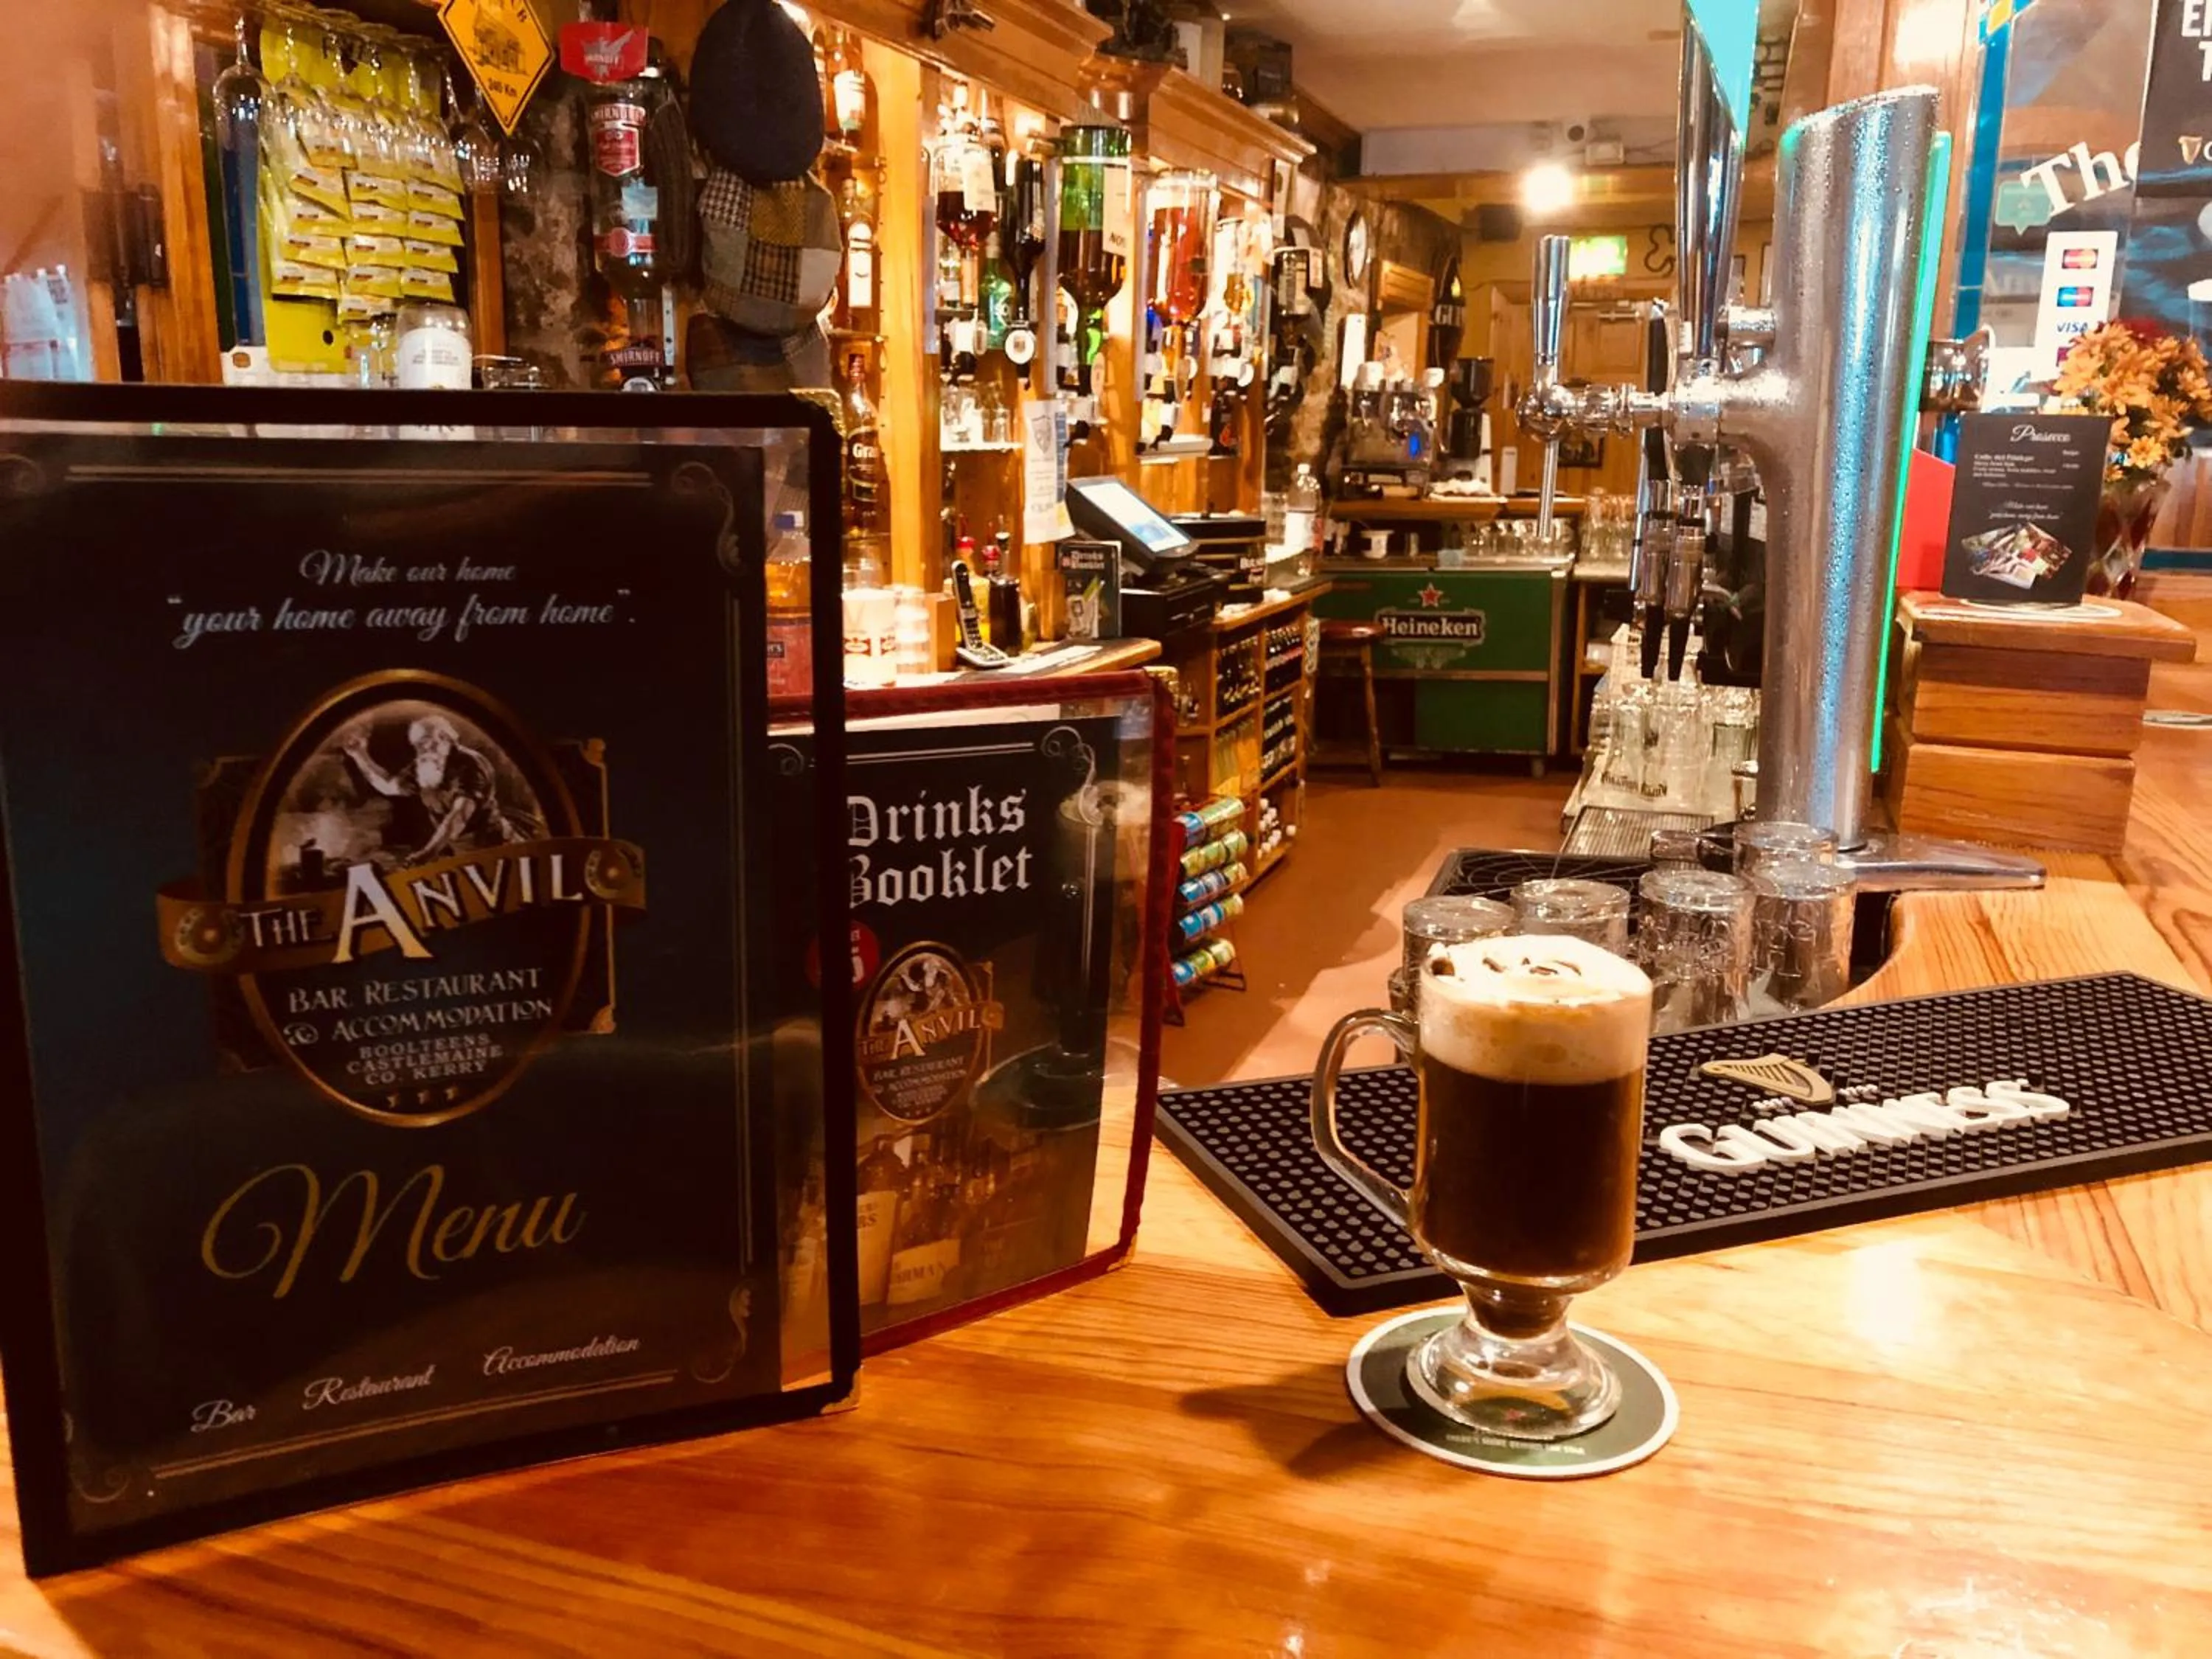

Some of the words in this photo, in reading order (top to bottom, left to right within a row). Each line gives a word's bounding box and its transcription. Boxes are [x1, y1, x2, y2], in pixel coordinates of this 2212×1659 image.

[2056, 321, 2089, 333] VISA
[610, 349, 661, 365] SMIRNOFF
[299, 549, 396, 585] Make
[406, 563, 447, 582] our
[456, 557, 516, 582] home
[272, 598, 355, 631] home
[366, 605, 447, 641] away
[454, 593, 529, 642] from
[1382, 616, 1479, 636] Heineken
[847, 785, 1027, 847] Drinks
[849, 844, 1033, 909] Booklet
[239, 907, 333, 947] THE
[331, 854, 584, 964] ANVIL
[288, 987, 349, 1014] BAR
[364, 967, 543, 1005] RESTAURANT
[332, 998, 553, 1043] ACCOMMODATION
[891, 1009, 981, 1060] ANVIL
[346, 1044, 504, 1074] CASTLEMAINE
[358, 1032, 491, 1060] BOOLTEENS
[413, 1060, 487, 1080] KERRY
[1659, 1077, 2070, 1175] GUINNESS
[201, 1164, 587, 1298] Menu
[190, 1399, 257, 1433] Bar
[302, 1364, 437, 1410] Restaurant
[483, 1335, 640, 1376] Accommodation
